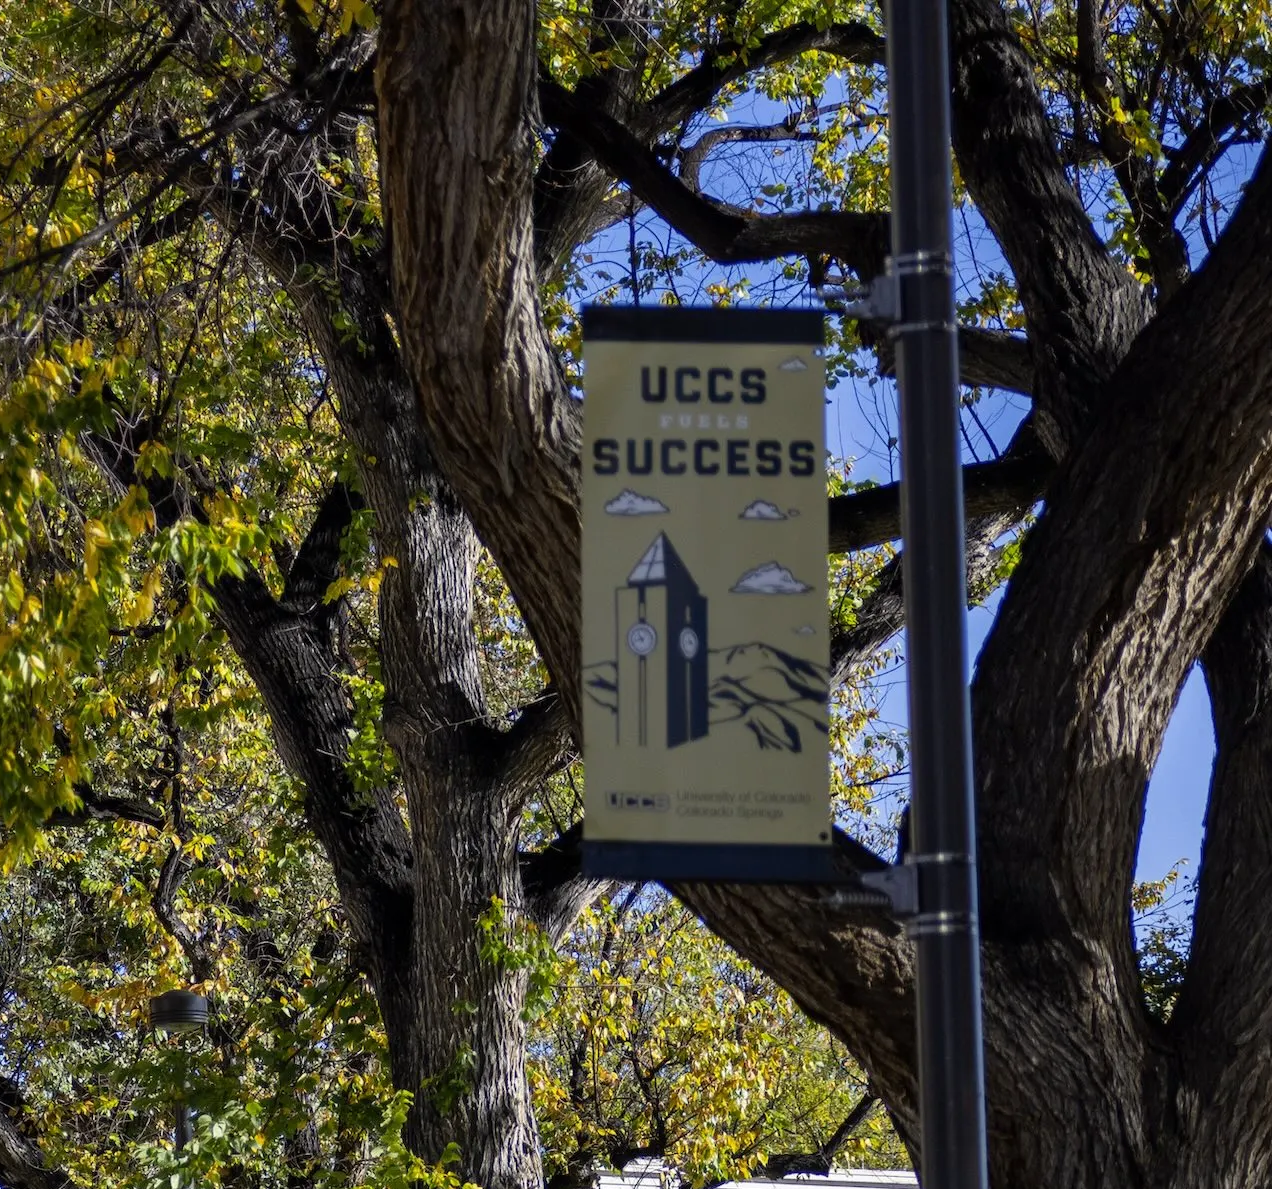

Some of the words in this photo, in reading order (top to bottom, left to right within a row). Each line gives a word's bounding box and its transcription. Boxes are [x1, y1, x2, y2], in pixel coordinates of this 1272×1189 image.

[640, 365, 768, 405] UCCS
[659, 412, 749, 430] FUELS
[592, 437, 816, 477] SUCCESS
[676, 790, 735, 804] University
[754, 791, 812, 805] Colorado
[676, 804, 733, 818] Colorado
[736, 805, 784, 820] Springs
